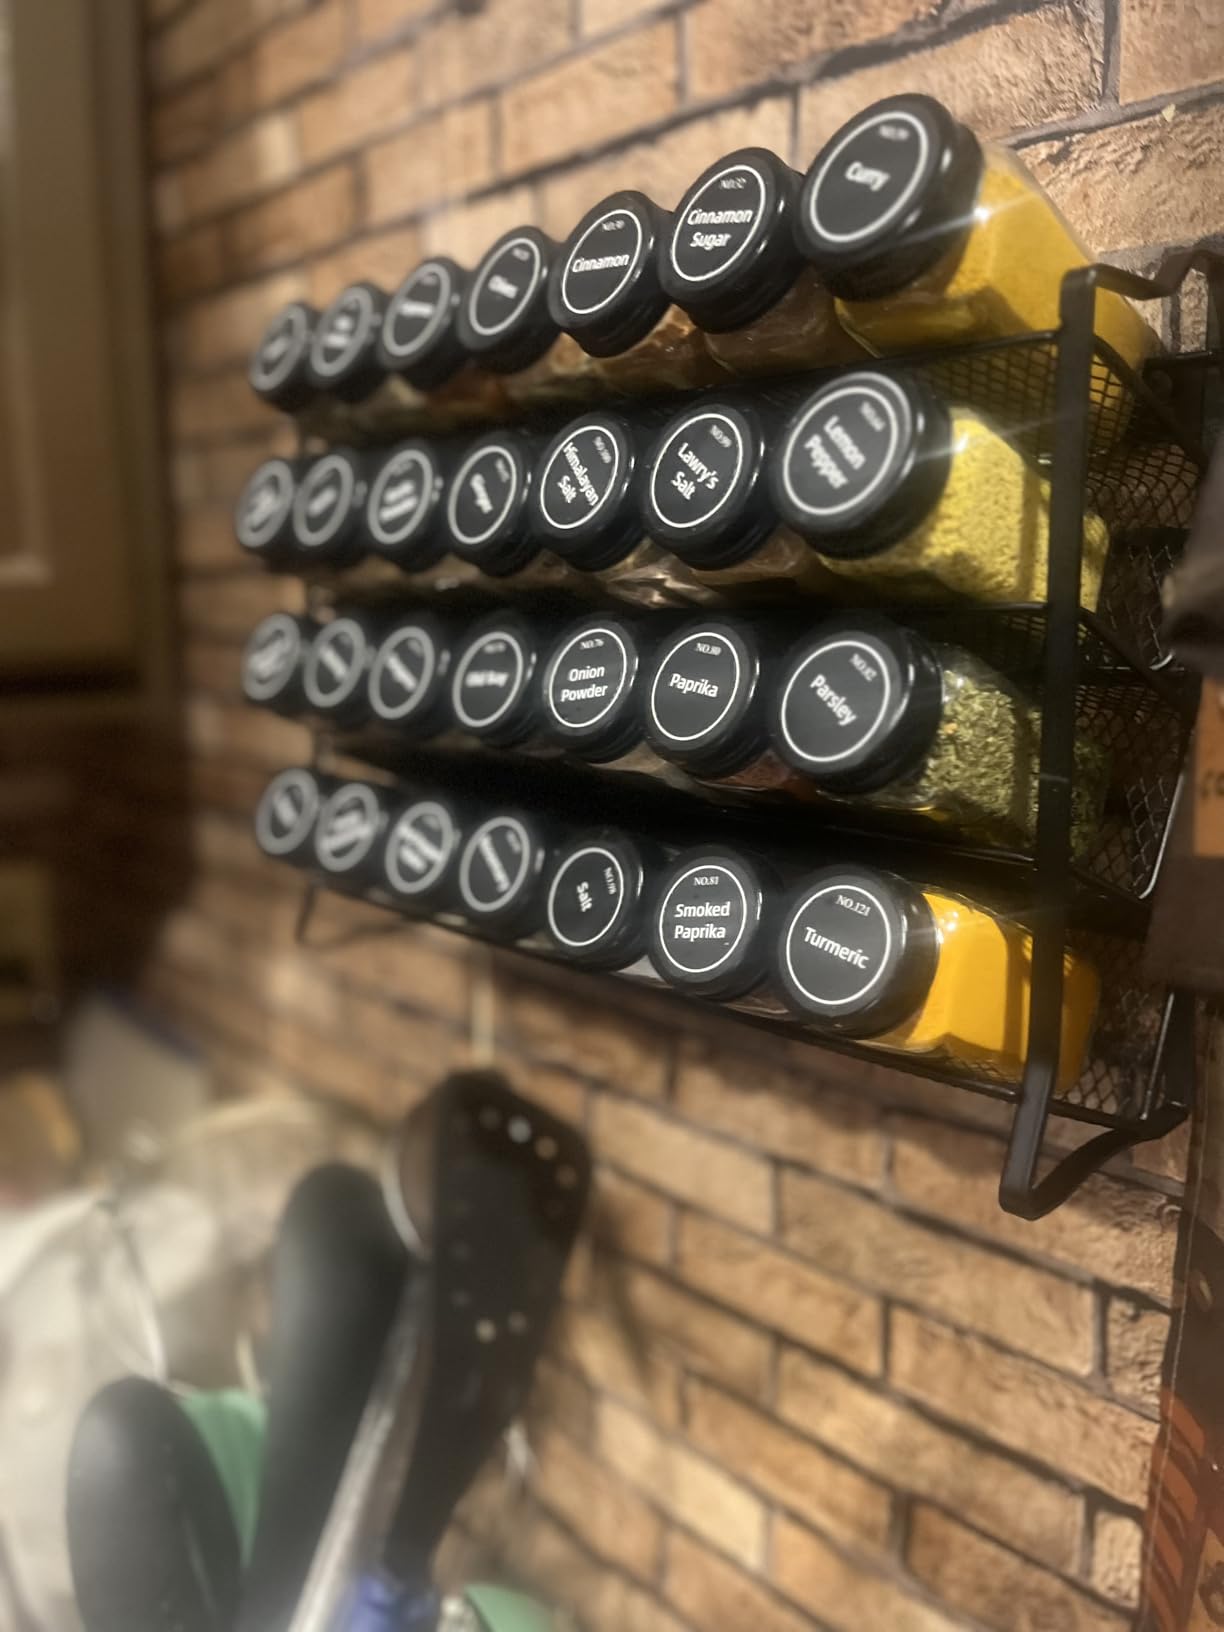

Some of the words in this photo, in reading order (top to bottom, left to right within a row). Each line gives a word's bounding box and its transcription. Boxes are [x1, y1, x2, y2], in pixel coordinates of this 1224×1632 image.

[845, 161, 890, 192] Curry
[687, 208, 753, 226] Cinnamon
[690, 232, 731, 251] Sugar
[572, 253, 629, 273] Cinnamon
[824, 415, 867, 471] Lemon
[563, 441, 600, 507] Himalayan
[678, 442, 719, 490] Lawry's
[557, 475, 577, 503] Salt
[671, 471, 697, 501] Salt
[569, 664, 605, 682] Onion
[669, 673, 720, 699] Paprika
[560, 683, 608, 702] Powder
[810, 674, 857, 727] Parsley
[693, 875, 720, 887] NO.81
[576, 881, 593, 913] Salt
[674, 902, 731, 918] Smoked
[835, 894, 871, 917] NO.121
[674, 923, 727, 943] Paprika
[803, 926, 871, 970] Turmeric
